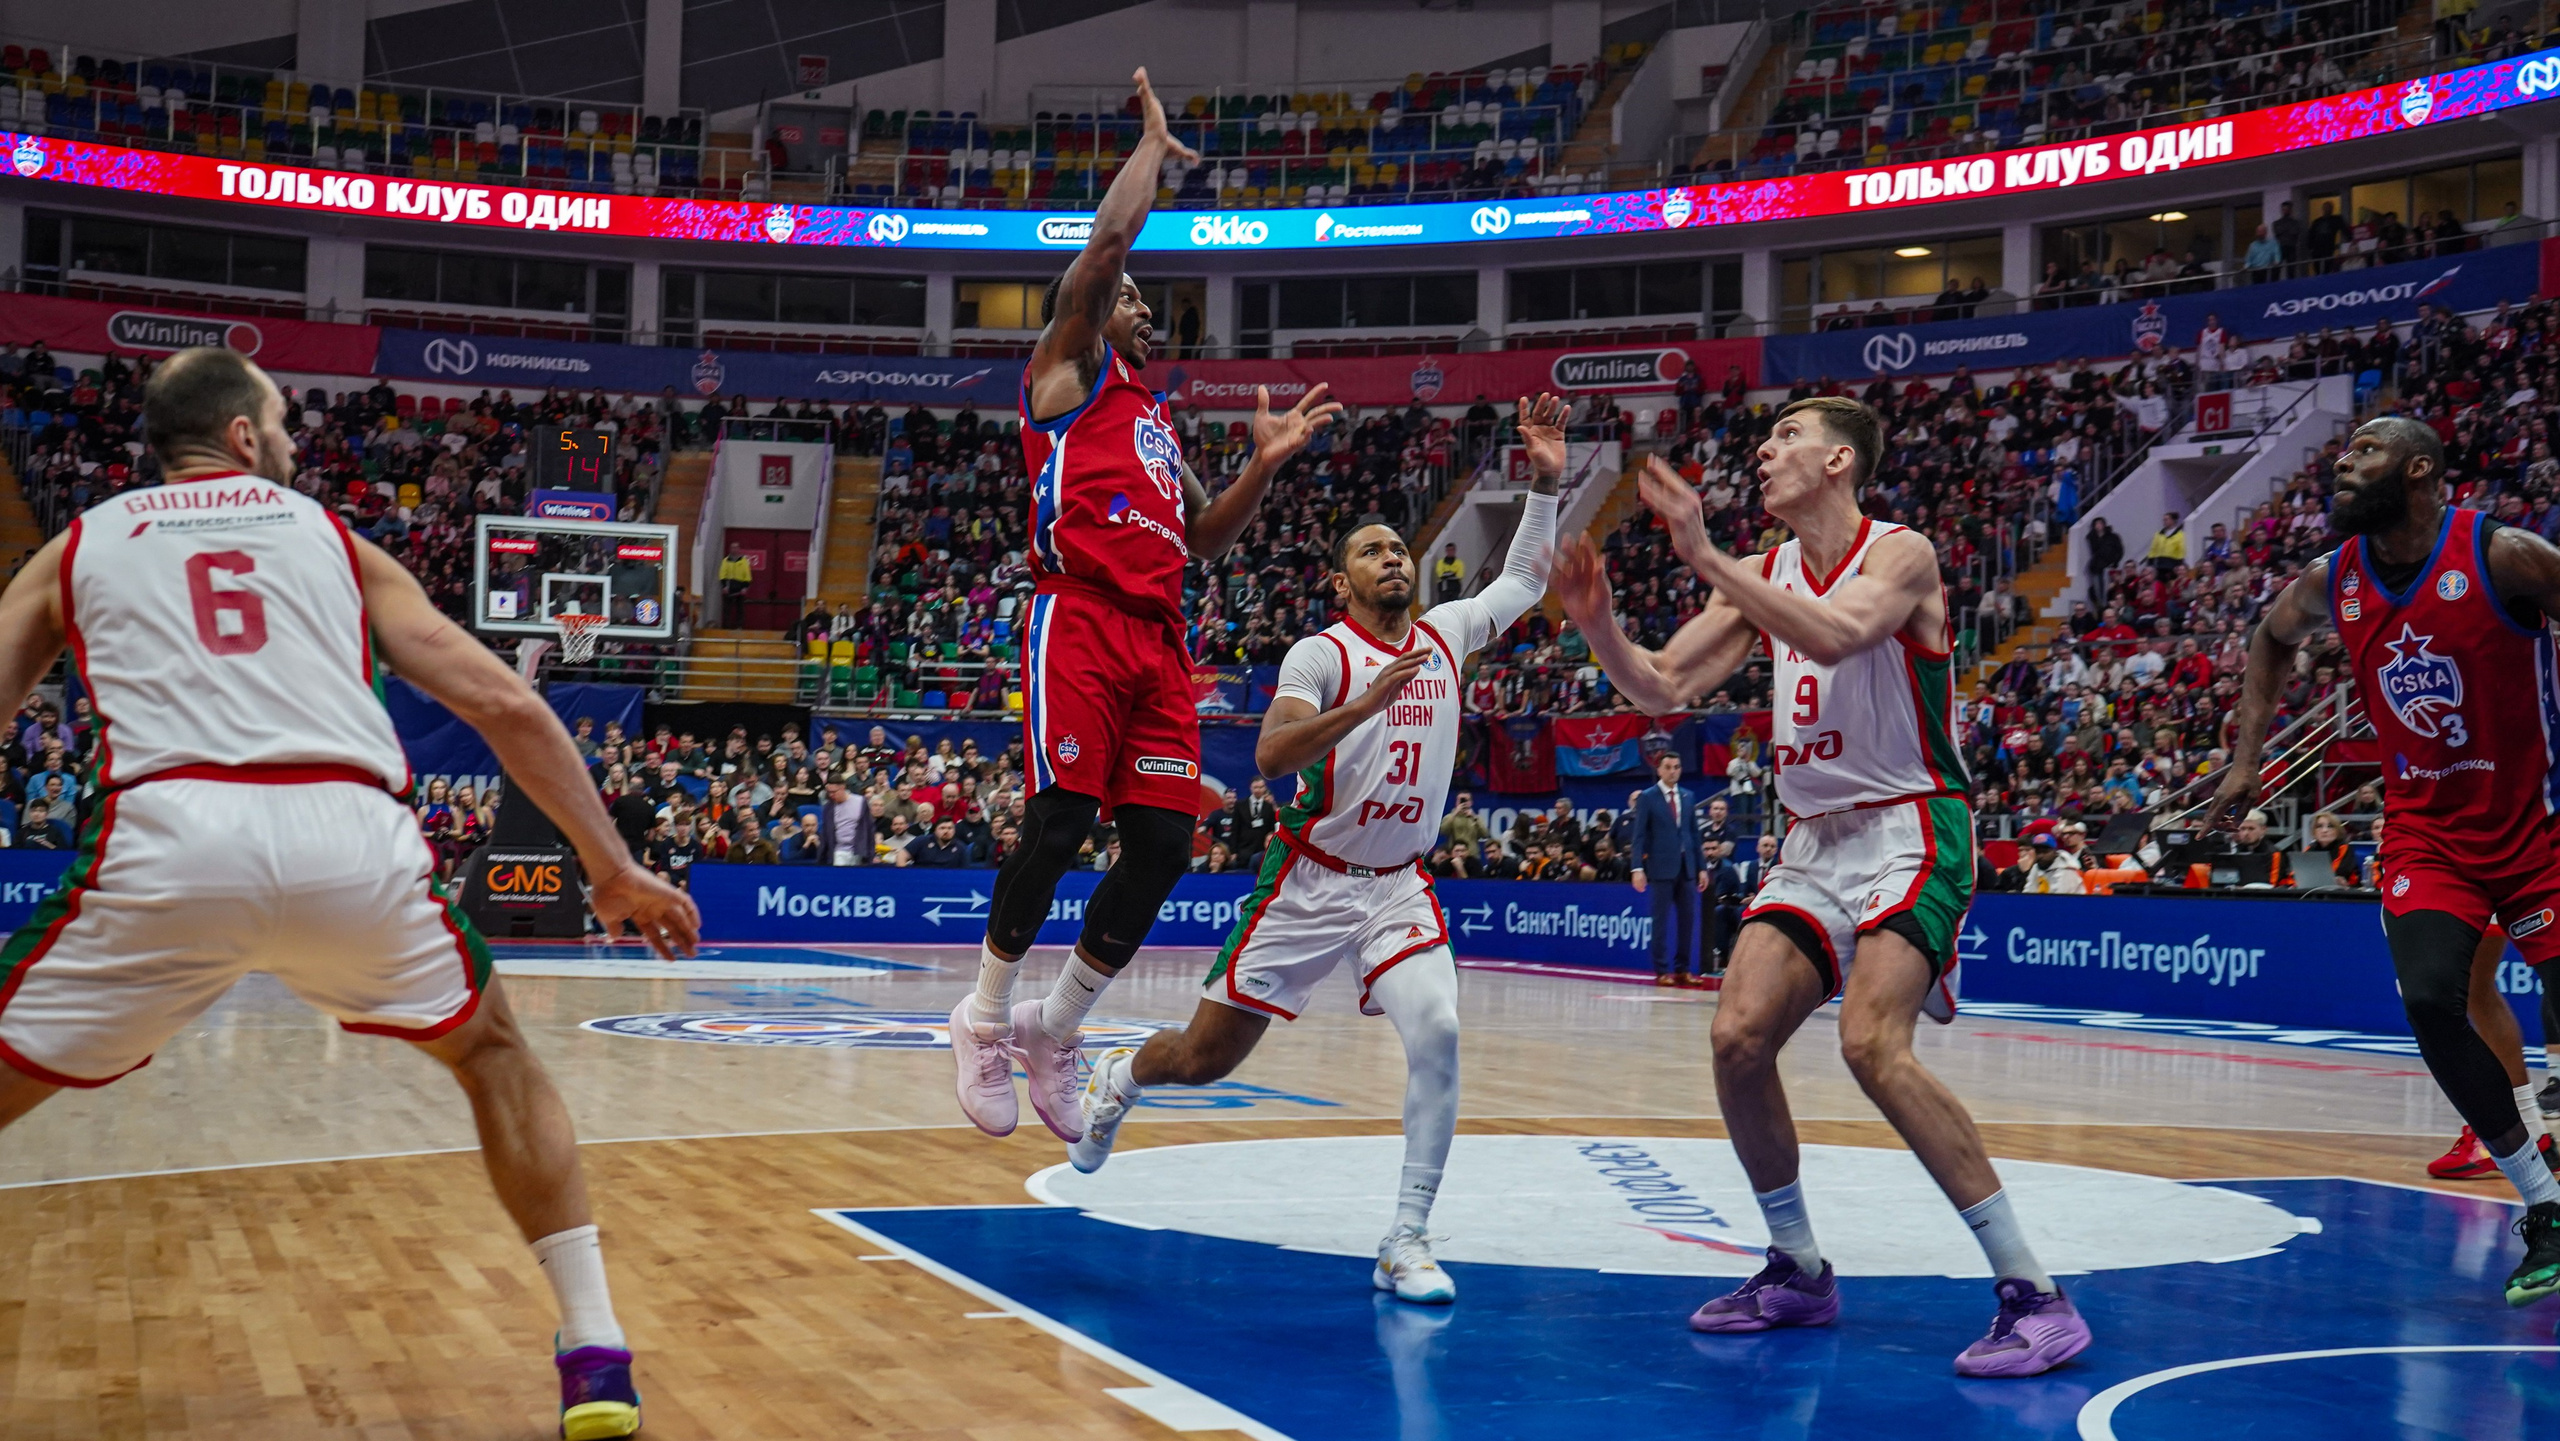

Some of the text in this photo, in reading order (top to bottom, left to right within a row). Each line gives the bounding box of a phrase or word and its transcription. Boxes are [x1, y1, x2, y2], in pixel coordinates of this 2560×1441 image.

[1844, 121, 2234, 207] ТОЛЬКО КЛУБ ОДИН
[216, 164, 611, 231] ТОЛЬКО КЛУБ ОДИН
[1333, 223, 1423, 240] Ростелеком
[2263, 281, 2418, 319] АЭРОФЛОТ
[121, 319, 218, 348] Winline
[1923, 332, 2029, 356] НОРНИКЕЛЬ
[485, 353, 591, 373] НОРНИКЕЛЬ
[1563, 359, 1651, 383] Winline
[814, 369, 954, 387] АЭРОФЛОТ
[1191, 379, 1306, 397] Ростелком
[1143, 431, 1181, 471] CSKA
[567, 455, 600, 483] 14
[123, 487, 286, 514] GUDUMAK
[543, 503, 591, 518] Winline
[491, 541, 537, 551] OLIMPBET
[618, 547, 662, 558] OLIMPBET
[185, 550, 268, 656] 6
[2389, 667, 2451, 695] CSKA
[1792, 674, 1820, 727] 9
[2441, 713, 2469, 748] 3
[1060, 744, 1078, 754] CSKA
[1386, 740, 1422, 786] 31
[1142, 760, 1185, 773] Winline
[2409, 759, 2495, 781] Ростелеком
[487, 864, 562, 893] GMS
[757, 885, 897, 919] Москва
[1504, 901, 1653, 951] Санкт-Петербур
[2514, 916, 2542, 936] Winline
[2006, 926, 2266, 987] Санкт-Петербург
